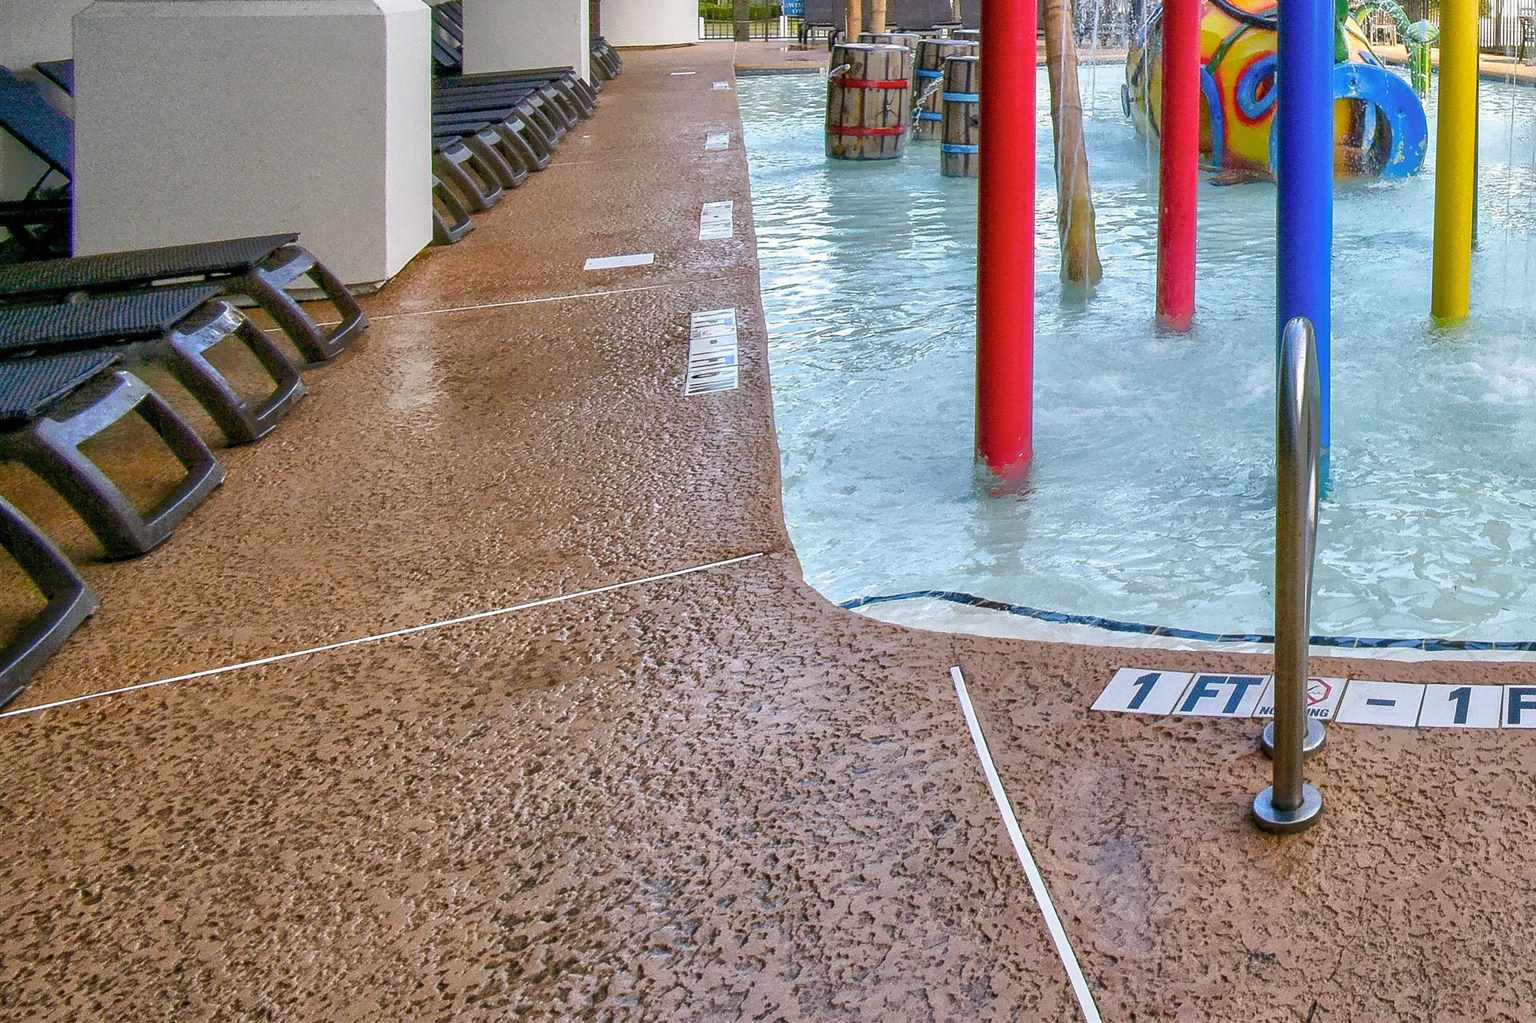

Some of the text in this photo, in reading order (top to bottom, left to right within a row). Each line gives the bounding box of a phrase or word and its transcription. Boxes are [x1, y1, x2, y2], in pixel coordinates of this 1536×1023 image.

[1126, 673, 1162, 710] 1
[1179, 675, 1265, 714] FT
[1448, 686, 1473, 725] 1
